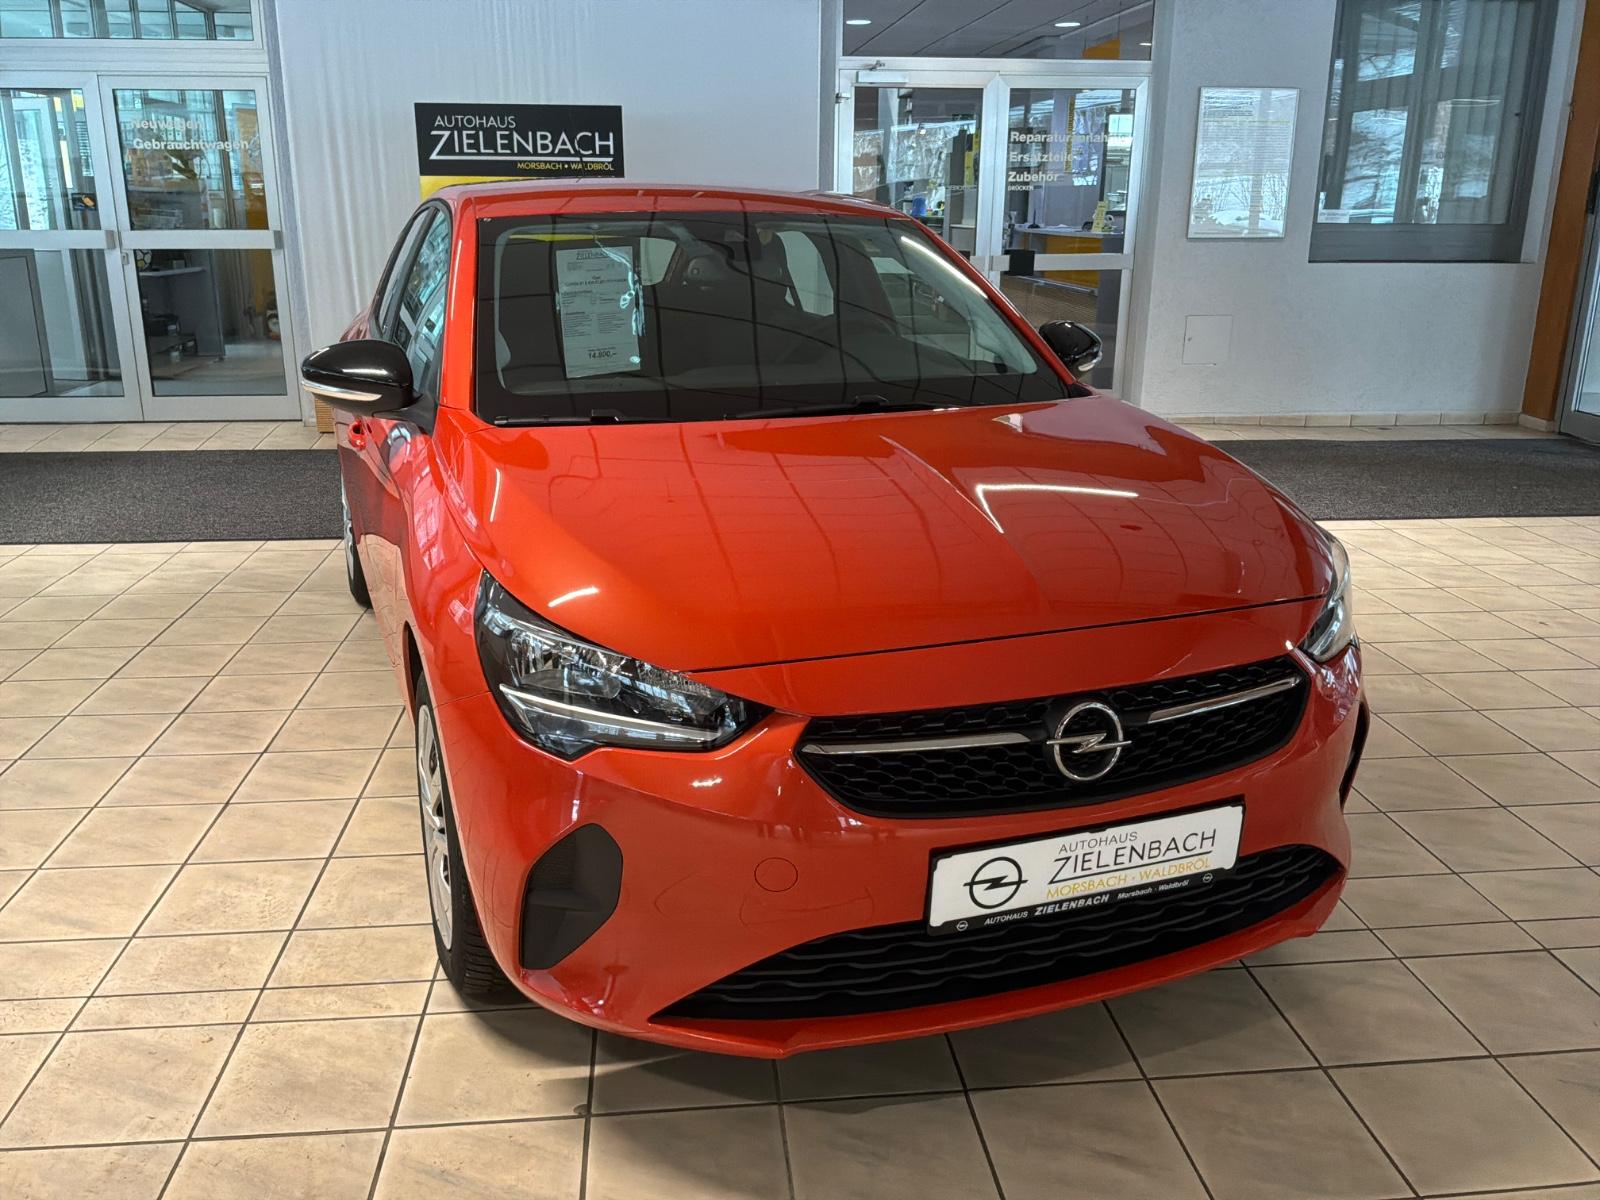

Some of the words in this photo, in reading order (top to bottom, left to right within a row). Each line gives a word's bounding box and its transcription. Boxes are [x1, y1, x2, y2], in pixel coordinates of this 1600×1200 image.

[434, 115, 517, 128] AUTOHAUS
[133, 138, 249, 152] Gebrauchtwagen
[1010, 131, 1128, 145] Reparaturnnah
[429, 131, 615, 161] ZIELENBACH
[1009, 151, 1073, 163] Ersatzteile
[517, 161, 563, 170] MORSBACH
[1007, 171, 1059, 182] Zubehör
[1058, 831, 1138, 855] AUTOHAUS
[1048, 829, 1217, 885] ZIELENBACH
[1046, 873, 1127, 900] MORSBACH
[984, 910, 1029, 926] AUTOHAUS
[1034, 894, 1110, 916] ZIELENBACH
[1117, 887, 1153, 899] Morsbach
[1158, 879, 1190, 892] Waldbröl
